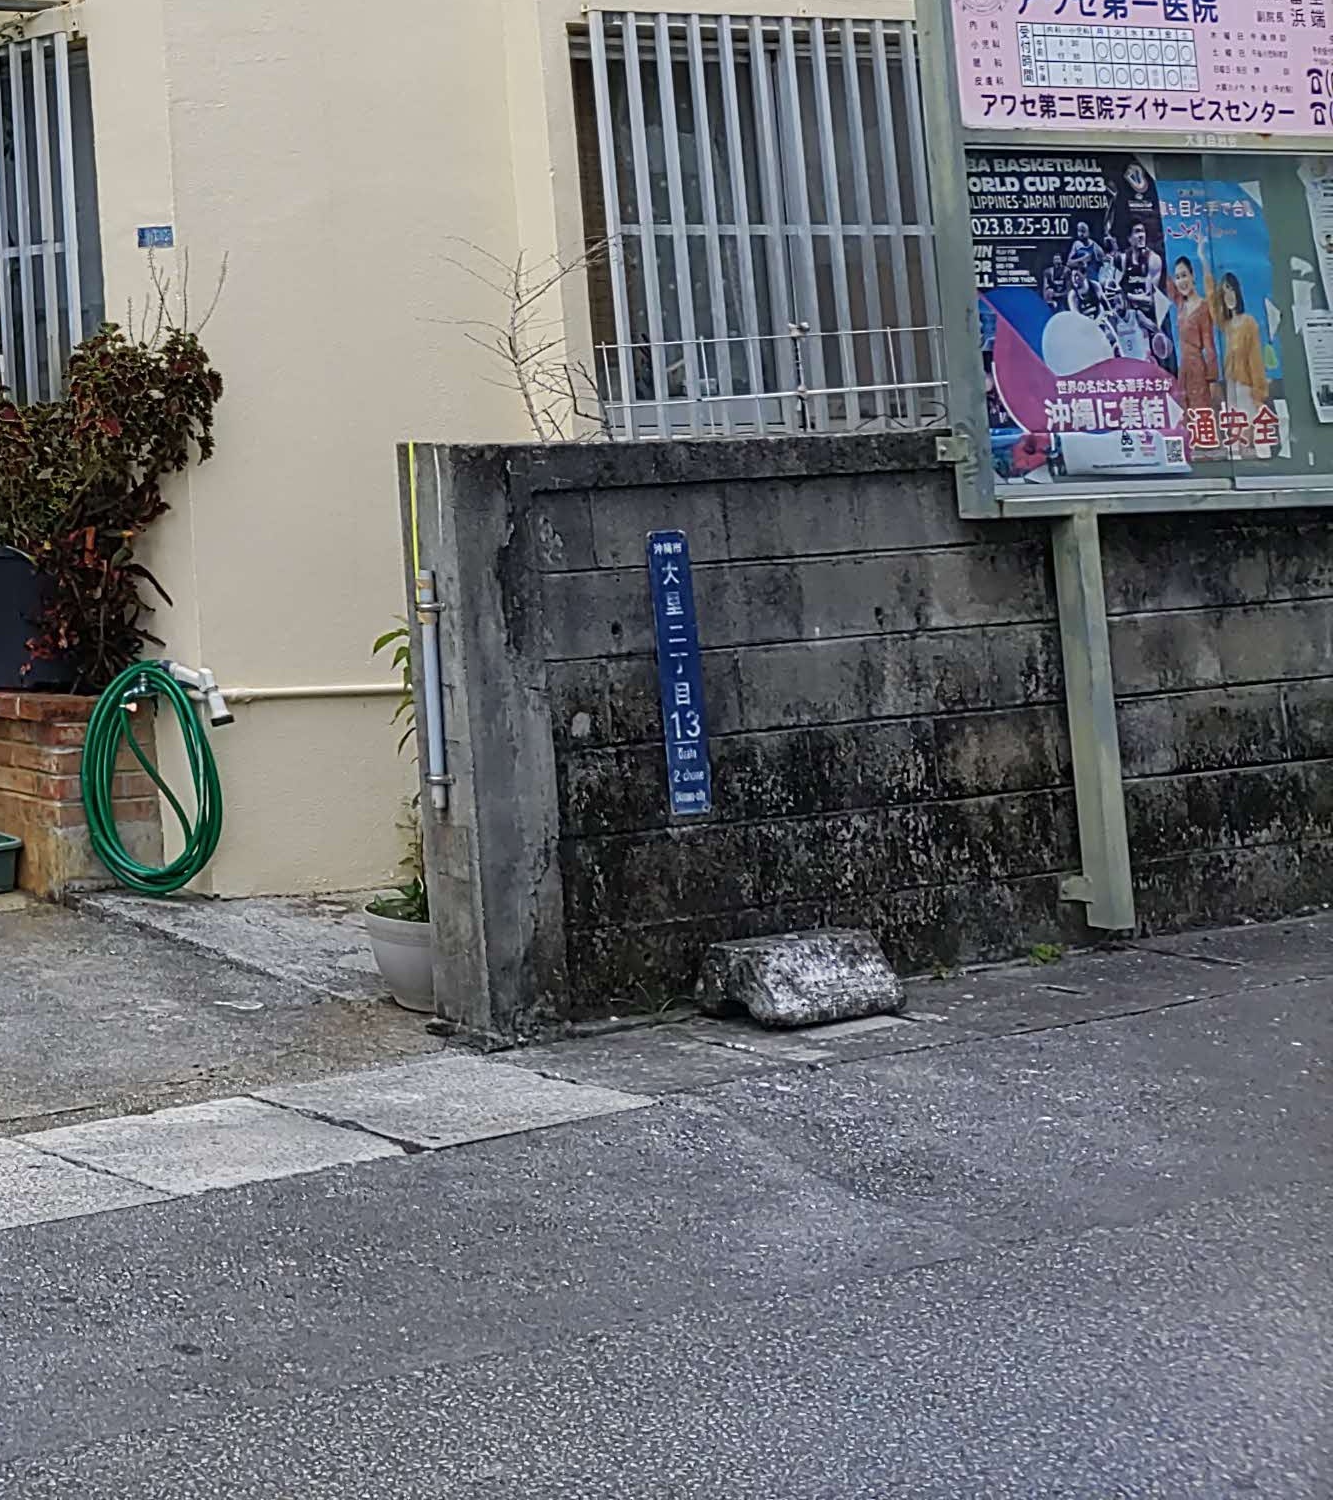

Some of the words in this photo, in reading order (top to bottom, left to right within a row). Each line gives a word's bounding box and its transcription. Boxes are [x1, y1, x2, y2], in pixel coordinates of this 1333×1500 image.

[980, 93, 1296, 124] アワセ第二医院デイサービスセンター
[967, 160, 991, 173] BA
[993, 158, 1102, 173] BASKETBALL
[969, 176, 1020, 192] ORLD
[1024, 176, 1061, 192] CUP
[1064, 176, 1106, 192] 2023
[972, 217, 1069, 235] 023.8.25-9.10
[1186, 404, 1280, 449] 通安全
[661, 561, 691, 706] 大里二丁目
[670, 708, 702, 741] 13
